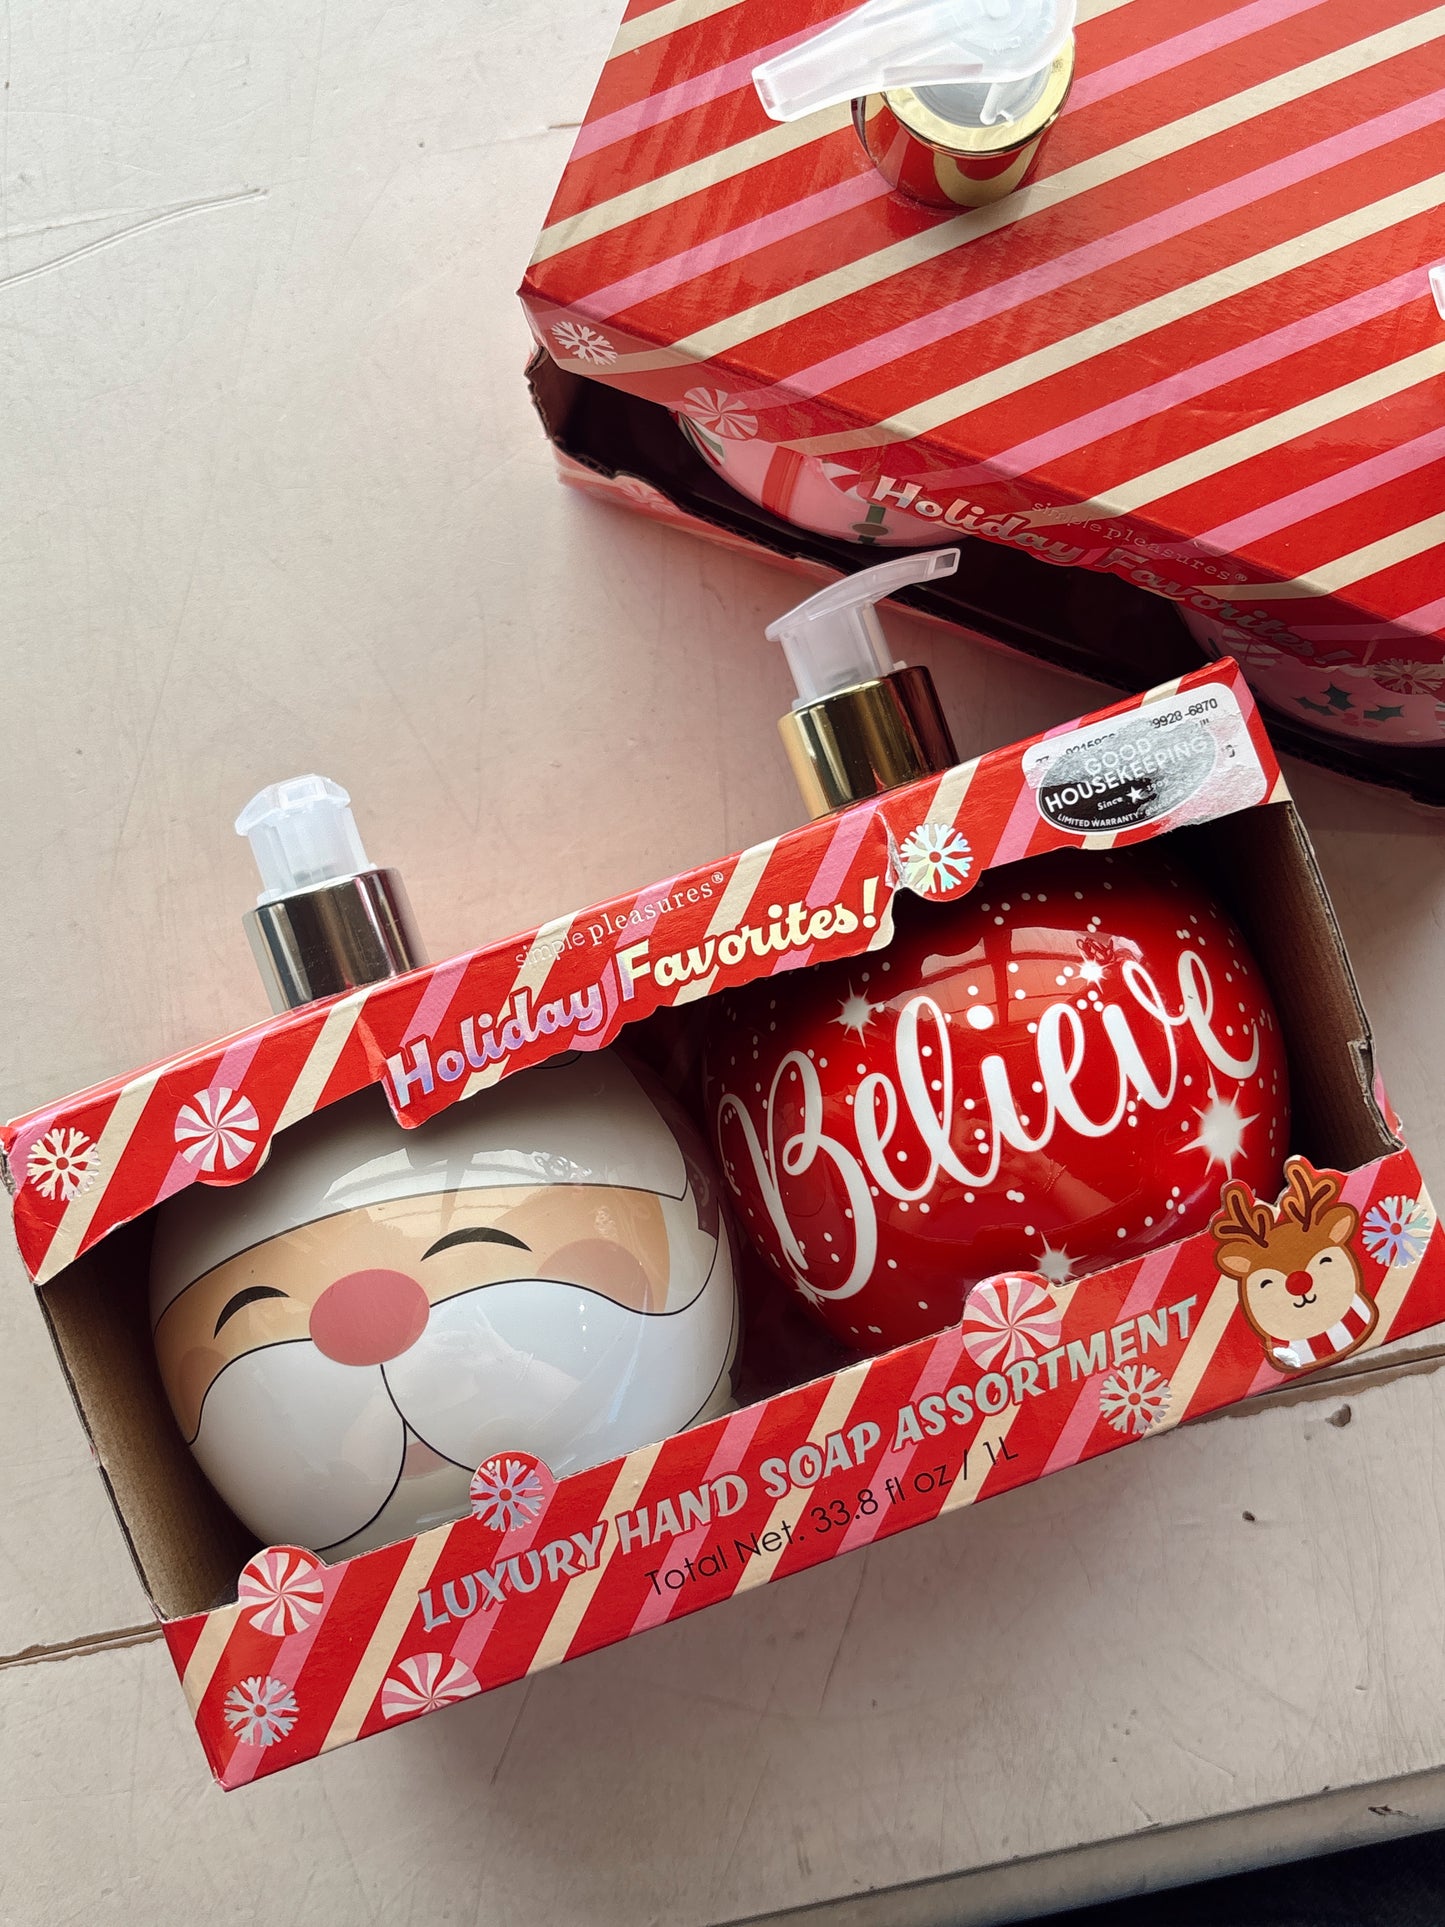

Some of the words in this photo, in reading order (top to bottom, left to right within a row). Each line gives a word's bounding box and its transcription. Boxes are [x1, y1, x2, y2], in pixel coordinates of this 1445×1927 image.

[1031, 501, 1102, 533] simple
[871, 475, 1085, 563] Holiday
[1094, 547, 1358, 665] Favorites!
[1044, 736, 1208, 813] HOUSEKEEPING
[1084, 737, 1152, 776] GOOD
[1056, 813, 1091, 828] LIMITED
[1091, 811, 1140, 828] WARRANTY
[1097, 795, 1124, 811] Since
[514, 930, 586, 969] simple
[386, 981, 602, 1107] Holiday
[615, 876, 878, 1002] Favorites!
[717, 949, 1260, 1300] Believe
[418, 1523, 605, 1632] LUXURY
[615, 1474, 749, 1556] HAND
[759, 1421, 881, 1498] SOAP
[893, 1294, 1198, 1452] ASSORTMENT
[644, 1545, 728, 1596] Total
[733, 1519, 806, 1564] Net.
[810, 1488, 879, 1534] 33.8
[884, 1476, 906, 1505] fl
[913, 1464, 952, 1494] oz
[982, 1435, 1019, 1466] 1L
